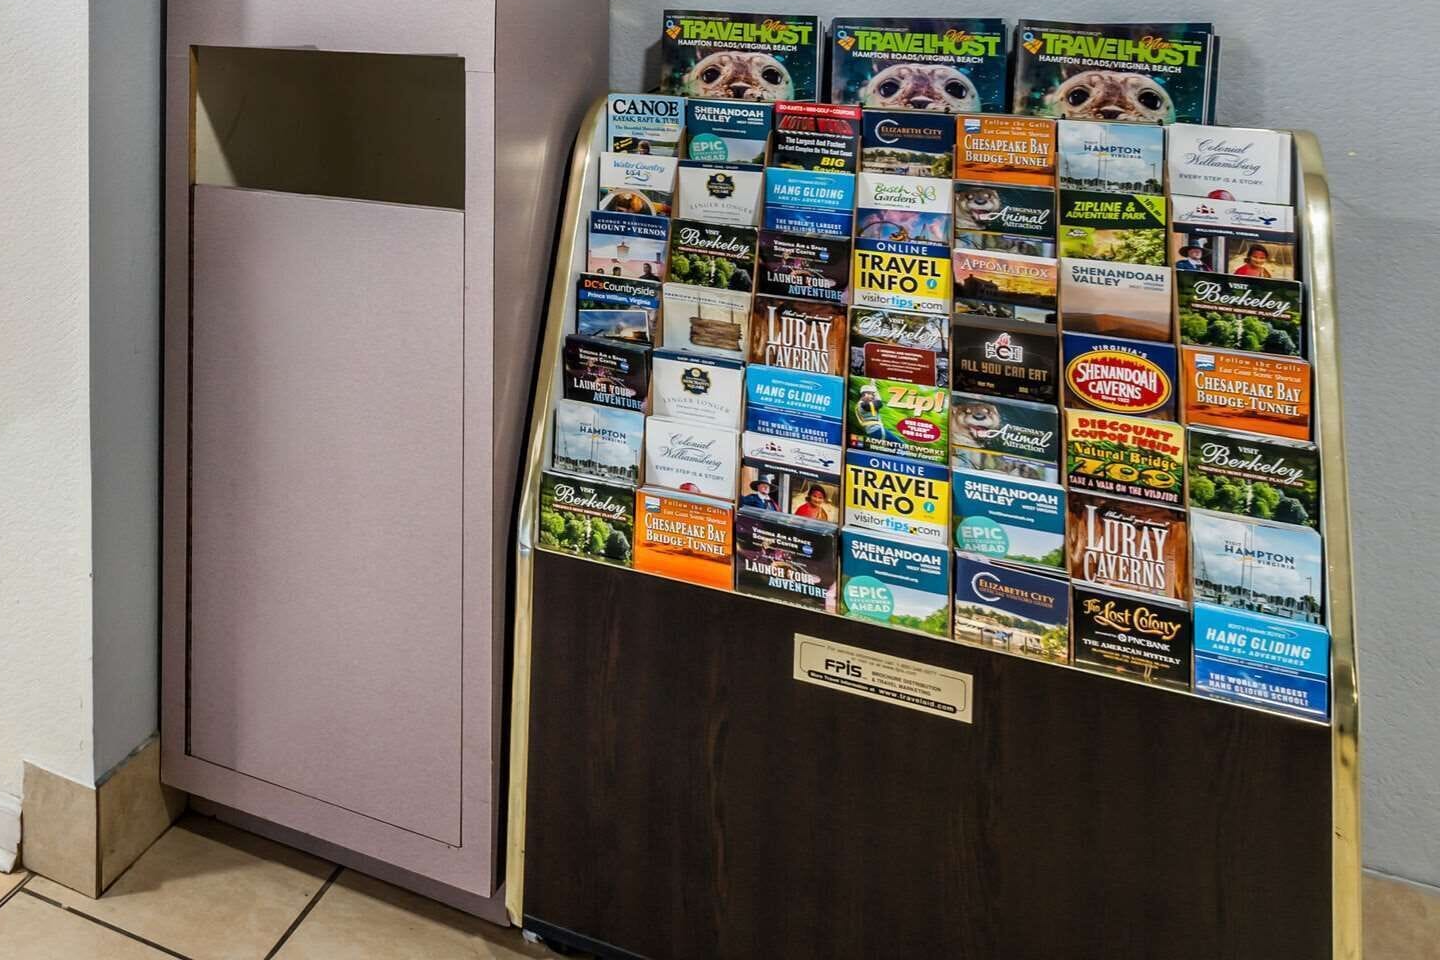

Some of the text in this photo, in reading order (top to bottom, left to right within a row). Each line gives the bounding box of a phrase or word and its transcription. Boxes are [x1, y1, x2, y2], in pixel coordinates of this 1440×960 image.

[680, 20, 813, 45] TRAVELHOST
[855, 31, 1000, 56] TRAVELHOST
[1042, 32, 1201, 66] TRAVELHOST
[852, 51, 889, 59] HAMPTON
[1039, 55, 1080, 65] HAMPTON
[1152, 65, 1181, 73] BEACH
[613, 99, 679, 117] CANOE
[694, 106, 764, 117] SHENANDOAH
[695, 114, 731, 123] VALLEY
[881, 126, 921, 134] ELIZABETH
[693, 142, 723, 151] EPIC
[965, 134, 1049, 155] CHESAPEAKE BAY
[1084, 144, 1141, 154] HAMPTON
[821, 157, 845, 167] BIG
[966, 151, 1048, 167] BRIDGE-TUNNEL
[773, 184, 844, 199] HANG GLIDING
[874, 192, 917, 204] Gardens
[982, 205, 1050, 225] Animal
[1066, 210, 1145, 220] ADVENTURE PARK
[1074, 202, 1121, 211] ZIPLINE
[1124, 202, 1135, 211] &
[594, 223, 666, 237] MOUNT VERNON
[1003, 221, 1042, 230] Attraction
[680, 227, 750, 257] Berkeley
[876, 242, 928, 255] ONLINE
[858, 253, 940, 277] TRAVEL
[1072, 265, 1164, 282] SHENANDOAH
[768, 272, 831, 288] LAUNCH YOUR
[861, 272, 918, 293] INFO
[1072, 274, 1120, 286] VALLEY
[788, 286, 842, 300] ADVENTURE
[1193, 281, 1290, 316] Berkeley
[768, 306, 831, 352] LURAY
[765, 344, 828, 373] CAVERNS
[1092, 345, 1147, 359] VIRGINIA'S
[961, 360, 1048, 381] ALL YOU CAN EAT
[1076, 363, 1157, 393] SHENANDOAH
[574, 378, 631, 397] LAUNCH YOUR
[756, 385, 831, 406] HANG GLIDING
[1088, 381, 1141, 400] CAVERNS
[1195, 372, 1302, 402] CHESAPEAKE BAY
[593, 394, 642, 408] ADVENTURE
[1197, 390, 1299, 416] BRIDGE-TUNNEL
[580, 426, 626, 439] HAMPTON
[987, 424, 1053, 448] Animal
[1078, 418, 1173, 441] DISCOUNT
[1003, 441, 1044, 453] Attraction
[1072, 429, 1180, 455] COUPON INSIDE
[1238, 446, 1260, 454] VISIT
[1074, 442, 1177, 470] Natural Bridge
[1201, 442, 1303, 483] Berkeley
[870, 458, 925, 476] ONLINE
[1075, 458, 1176, 488] ZOO
[851, 468, 938, 500] TRAVEL
[965, 481, 1058, 505] SHENANDOAH
[1069, 476, 1086, 486] TAKE
[1096, 480, 1113, 490] WALK
[1116, 484, 1126, 492] ON
[1129, 486, 1141, 495] THE
[554, 484, 625, 517] Berkeley
[853, 488, 914, 514] INFO
[965, 491, 1013, 506] VALLEY
[645, 512, 726, 542] CHESAPEAKE BAY
[963, 526, 1003, 539] EPIC
[1086, 505, 1168, 563] LURAY
[646, 529, 725, 556] BRIDGE-TUNNEL
[964, 543, 1005, 553] AHEAD
[851, 540, 941, 565] SHENANDOAH
[851, 549, 899, 566] VALLEY
[1224, 545, 1295, 564] HAMPTON
[745, 559, 816, 585] LAUNCH YOUR
[1084, 550, 1165, 590] CAVERNS
[769, 578, 827, 598] ADVENTURE
[848, 586, 887, 597] EPIC
[979, 579, 1029, 597] ELIZABETH
[1031, 592, 1055, 603] CITY
[848, 602, 890, 612] AHEAD
[1083, 598, 1101, 614] The
[1094, 601, 1131, 631] Lost
[1133, 607, 1181, 640] Colony
[1082, 638, 1099, 647] THE
[1101, 642, 1142, 655] AMERICAN
[1143, 651, 1181, 664] MYSTERY
[1206, 628, 1311, 659] HANG GLIDING
[1248, 650, 1304, 666] ADVENTURES
[1209, 680, 1231, 690] HANG
[1234, 685, 1269, 698] GLIDING
[1210, 672, 1308, 698] THE WORLD'S LARGEST
